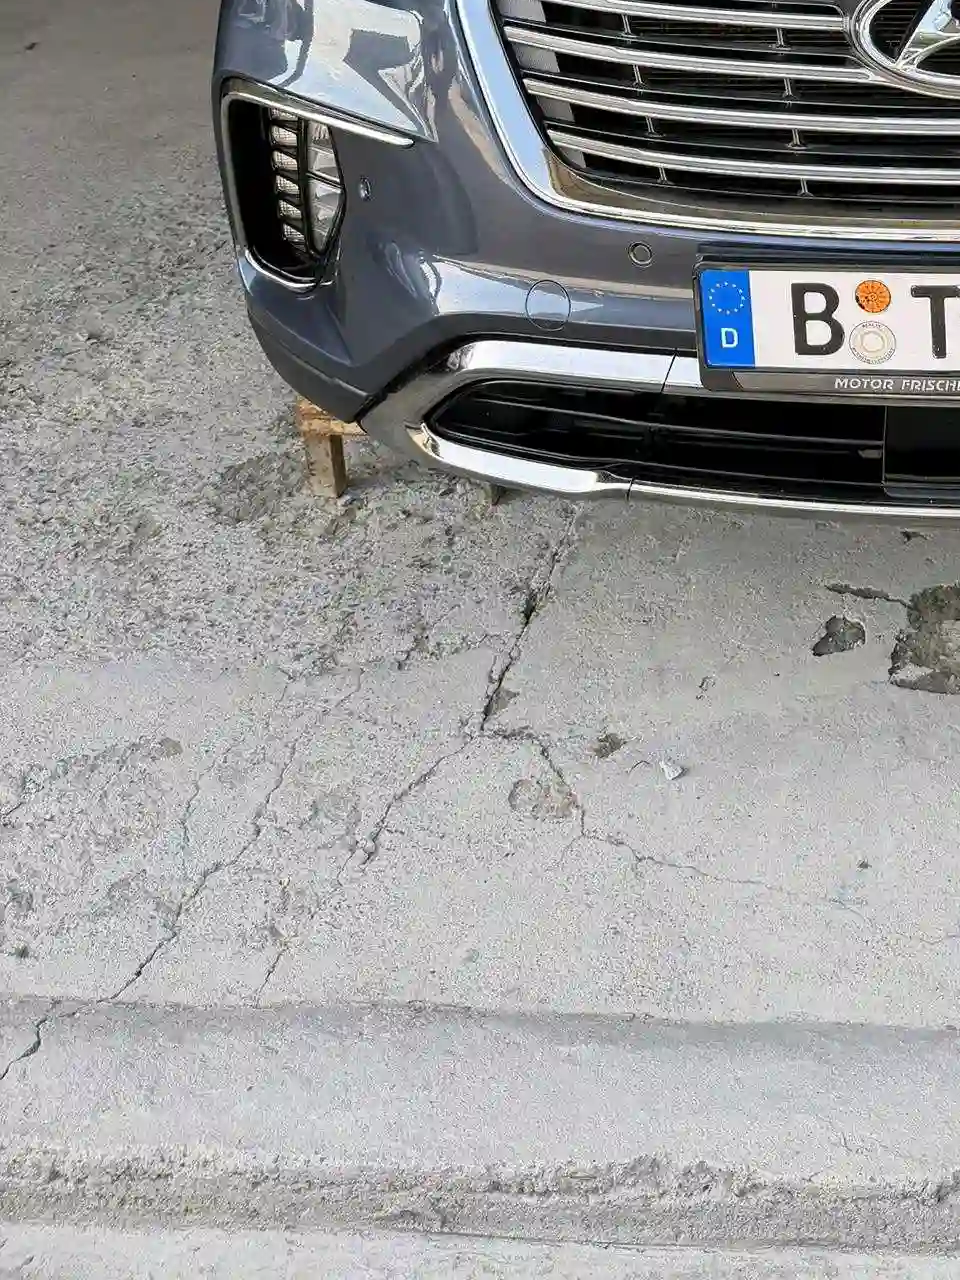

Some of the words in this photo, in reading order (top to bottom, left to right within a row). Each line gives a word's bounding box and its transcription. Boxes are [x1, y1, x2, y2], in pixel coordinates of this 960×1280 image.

[791, 282, 845, 356] B
[720, 326, 739, 349] D
[834, 378, 894, 391] MOTOR
